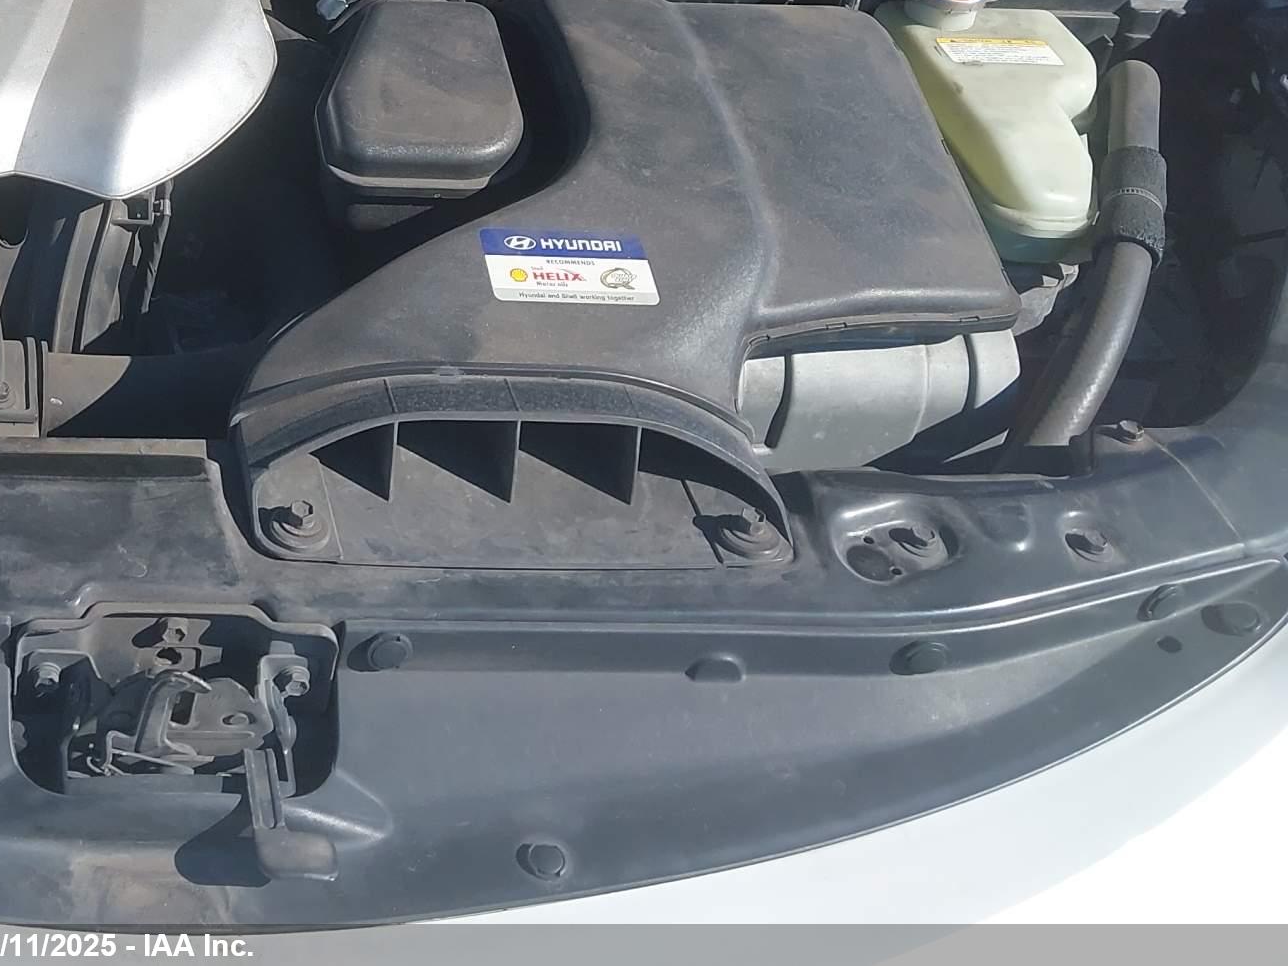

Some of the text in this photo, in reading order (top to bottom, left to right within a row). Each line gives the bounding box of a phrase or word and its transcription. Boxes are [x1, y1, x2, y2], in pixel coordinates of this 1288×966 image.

[540, 238, 622, 252] HYUNDAI
[532, 272, 583, 282] HELIX
[580, 294, 606, 302] working
[607, 294, 635, 302] together
